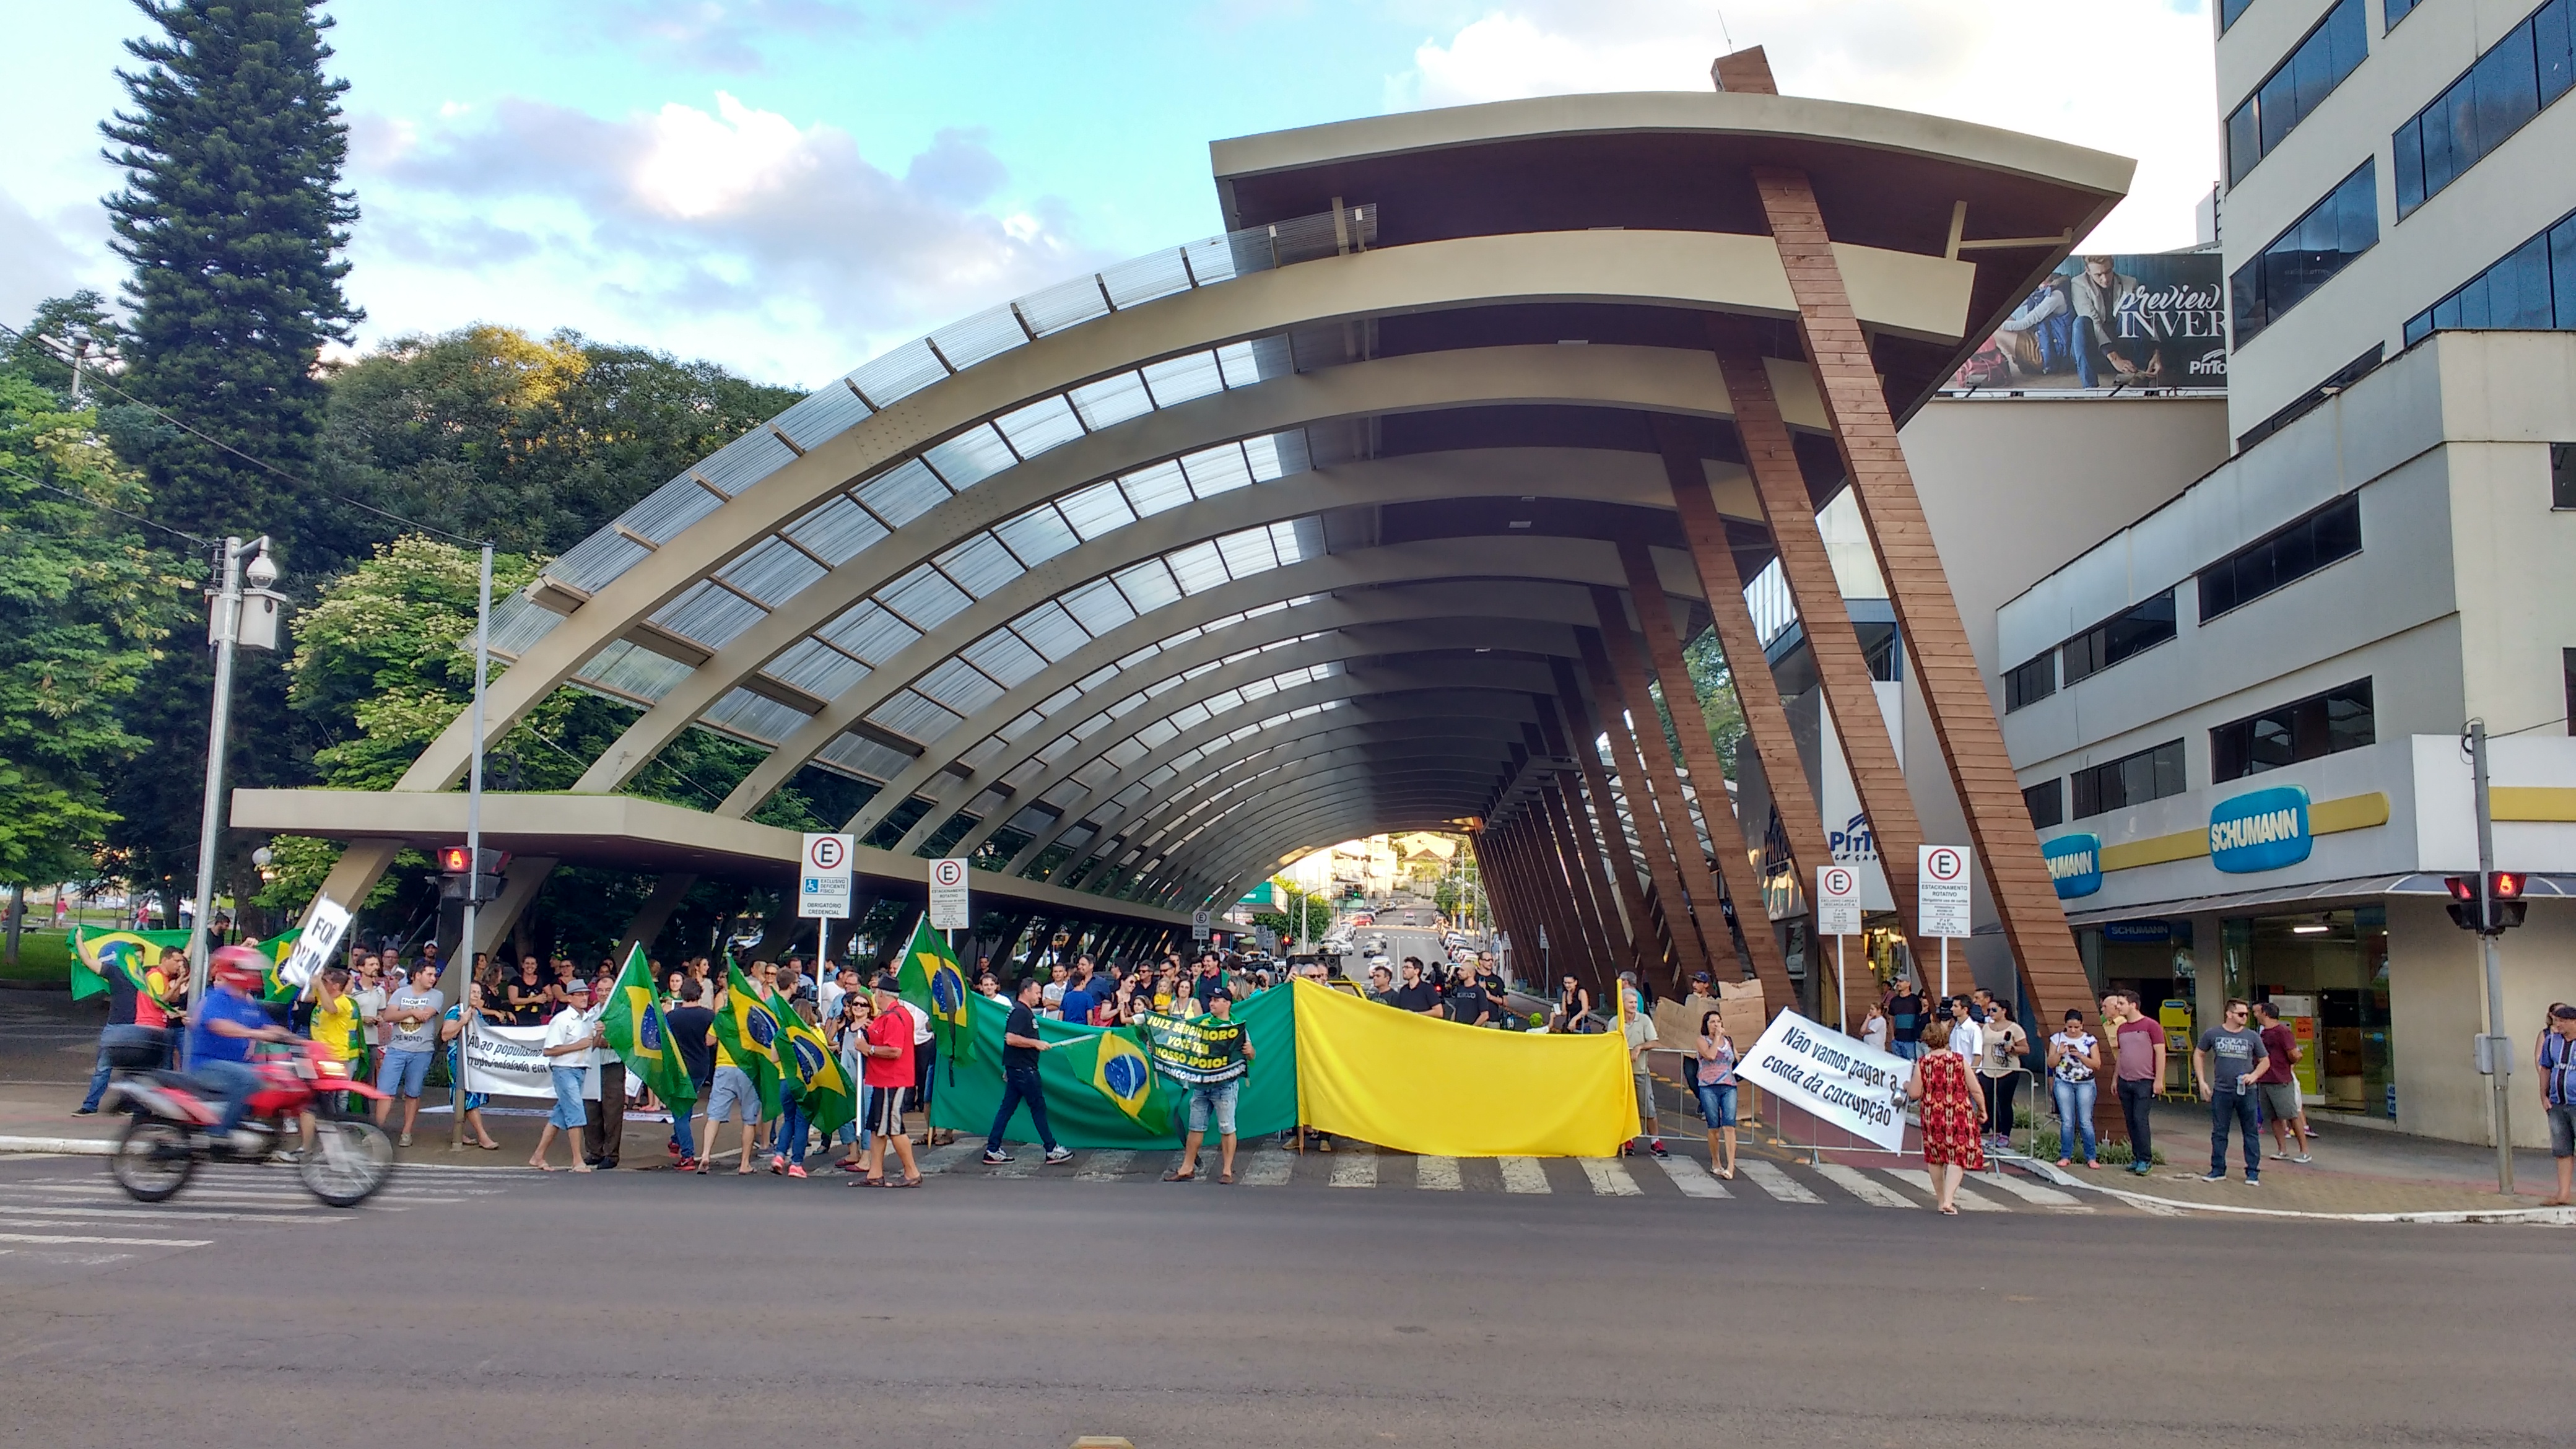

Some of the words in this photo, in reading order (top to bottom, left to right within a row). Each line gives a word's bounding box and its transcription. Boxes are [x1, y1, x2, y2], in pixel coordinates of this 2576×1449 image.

[2113, 284, 2221, 318] preview
[2211, 807, 2298, 853] SCHUMANN
[821, 843, 833, 863] E
[944, 866, 953, 880] E
[1939, 855, 1951, 874] E
[1834, 874, 1843, 890] E
[2111, 926, 2169, 935] SCHUMANN
[1147, 1016, 1172, 1030] JUIZ
[1172, 1021, 1203, 1037] SÉRGIO
[1203, 1029, 1239, 1041] MORO
[481, 1040, 494, 1051] ao
[494, 1043, 543, 1057] populismo
[1167, 1035, 1191, 1050] VOCÊ
[1192, 1041, 1209, 1055] TEM
[531, 1063, 547, 1073] em
[1155, 1047, 1186, 1063] NOSSO
[1187, 1056, 1228, 1069] APOIO!
[1781, 1026, 1811, 1053] Não
[1811, 1042, 1850, 1072] vamos
[1848, 1058, 1886, 1087] pagar
[1890, 1074, 1897, 1092] a
[1164, 1066, 1202, 1083] CONCORDA
[1762, 1055, 1803, 1087] conta
[1803, 1073, 1824, 1094] da
[1823, 1084, 1891, 1126] corrupção
